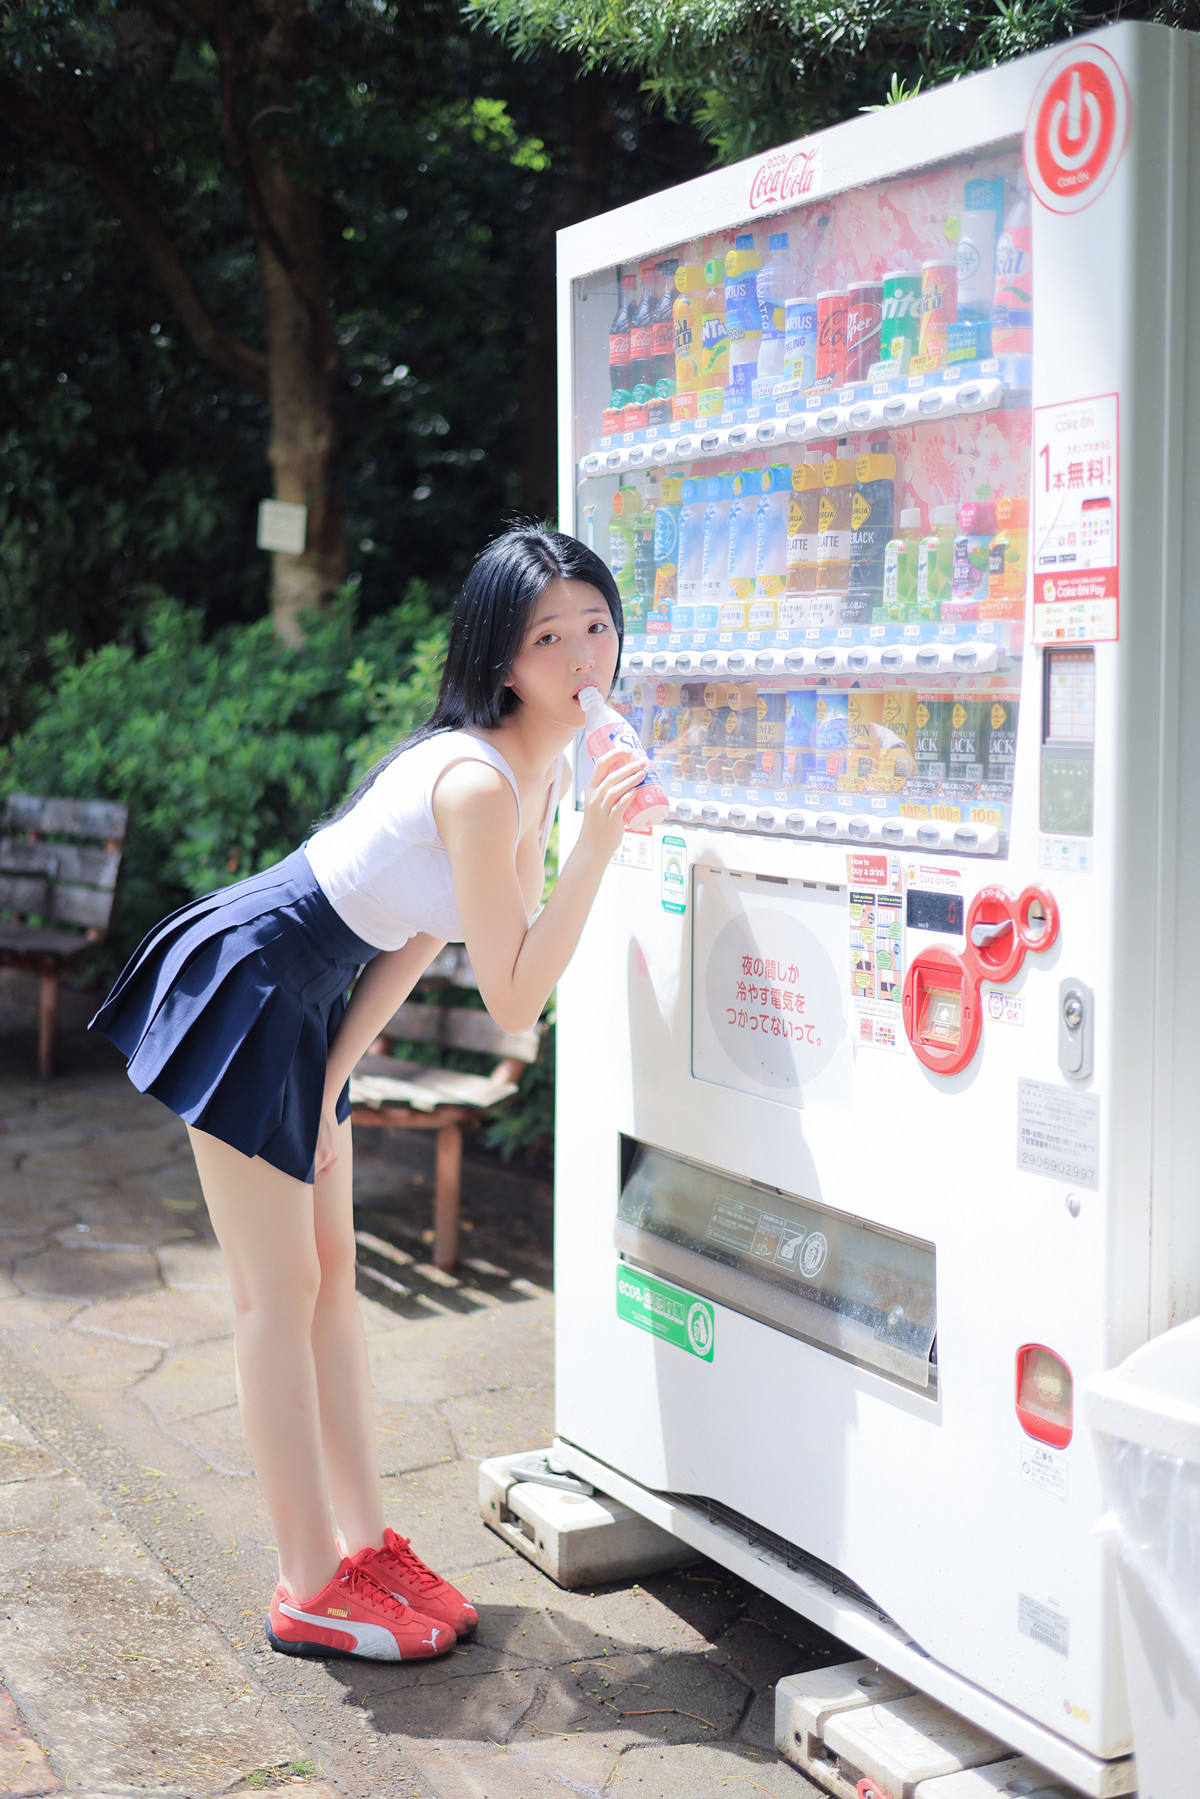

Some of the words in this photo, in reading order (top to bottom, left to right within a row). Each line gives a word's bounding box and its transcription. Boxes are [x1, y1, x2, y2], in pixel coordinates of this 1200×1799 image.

[749, 149, 818, 210] Coca-Cola
[1090, 583, 1106, 598] Pay
[851, 858, 863, 866] How
[851, 867, 864, 877] buy
[869, 868, 886, 877] drink
[741, 954, 800, 984] 夜の間しか
[735, 980, 806, 1014] 冷やす電気を
[1007, 1009, 1019, 1021] OK
[726, 1007, 822, 1047] つかってないって。
[1021, 1151, 1096, 1182] 2906902997
[327, 1607, 348, 1619] PUMA
